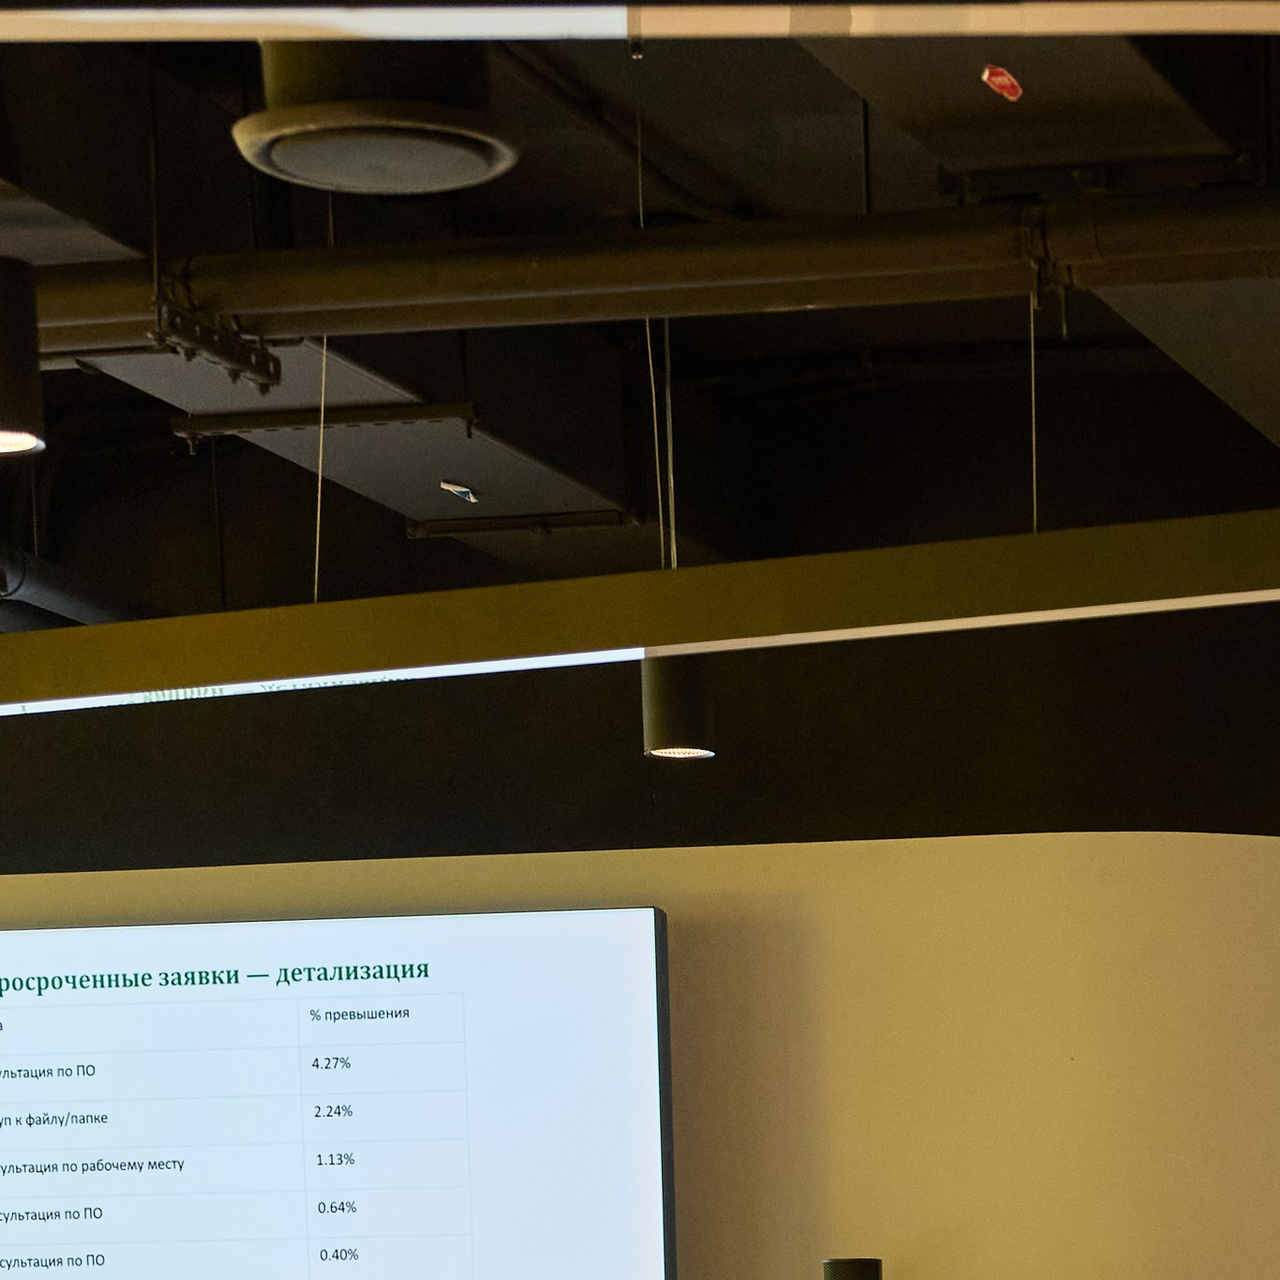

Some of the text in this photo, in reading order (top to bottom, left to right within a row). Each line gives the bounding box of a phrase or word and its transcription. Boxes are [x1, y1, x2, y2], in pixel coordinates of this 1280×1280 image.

[159, 970, 239, 986] заявки
[276, 963, 429, 987] детализация
[310, 1009, 409, 1023] % превышения
[312, 1057, 351, 1069] 4.27%
[0, 1065, 95, 1080] льтация по ПО
[315, 1105, 353, 1117] 2.24%
[16, 1117, 22, 1125] к
[26, 1112, 108, 1128] файлу/папке
[317, 1153, 355, 1166] 1.13%
[0, 1159, 184, 1176] ультация по рабочему месту
[65, 1211, 80, 1219] по
[84, 1207, 102, 1219] ПО
[318, 1201, 357, 1213] 0.64%
[320, 1249, 359, 1261] 0.40%
[0, 1254, 105, 1270] сультация по ПО
